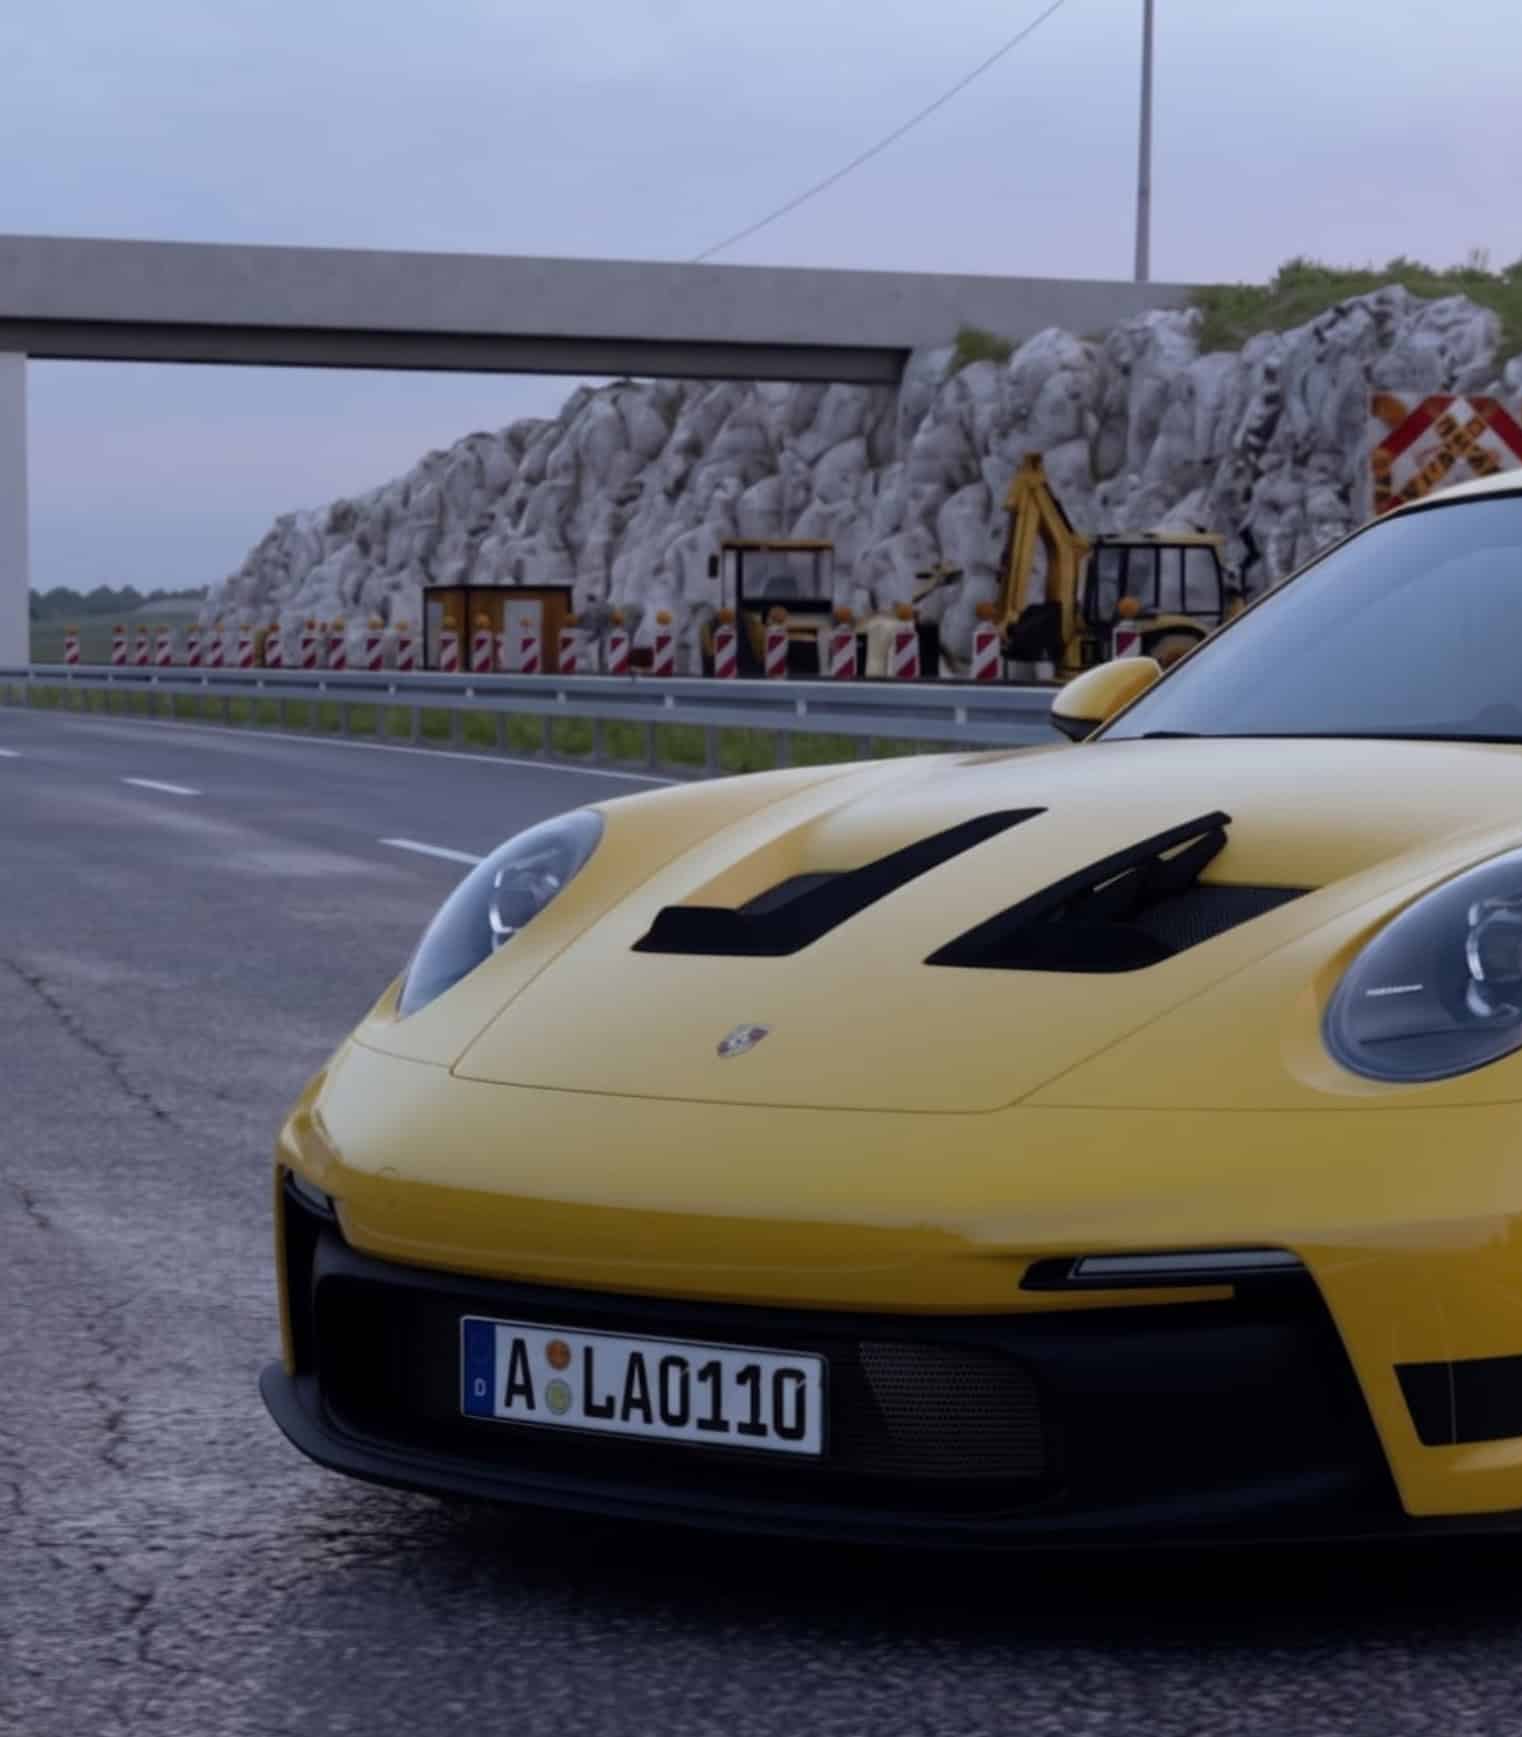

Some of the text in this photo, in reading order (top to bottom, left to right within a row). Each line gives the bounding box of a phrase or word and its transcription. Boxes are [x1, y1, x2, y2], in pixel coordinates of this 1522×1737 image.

[474, 1378, 487, 1397] D
[504, 1338, 807, 1441] A LA0110
